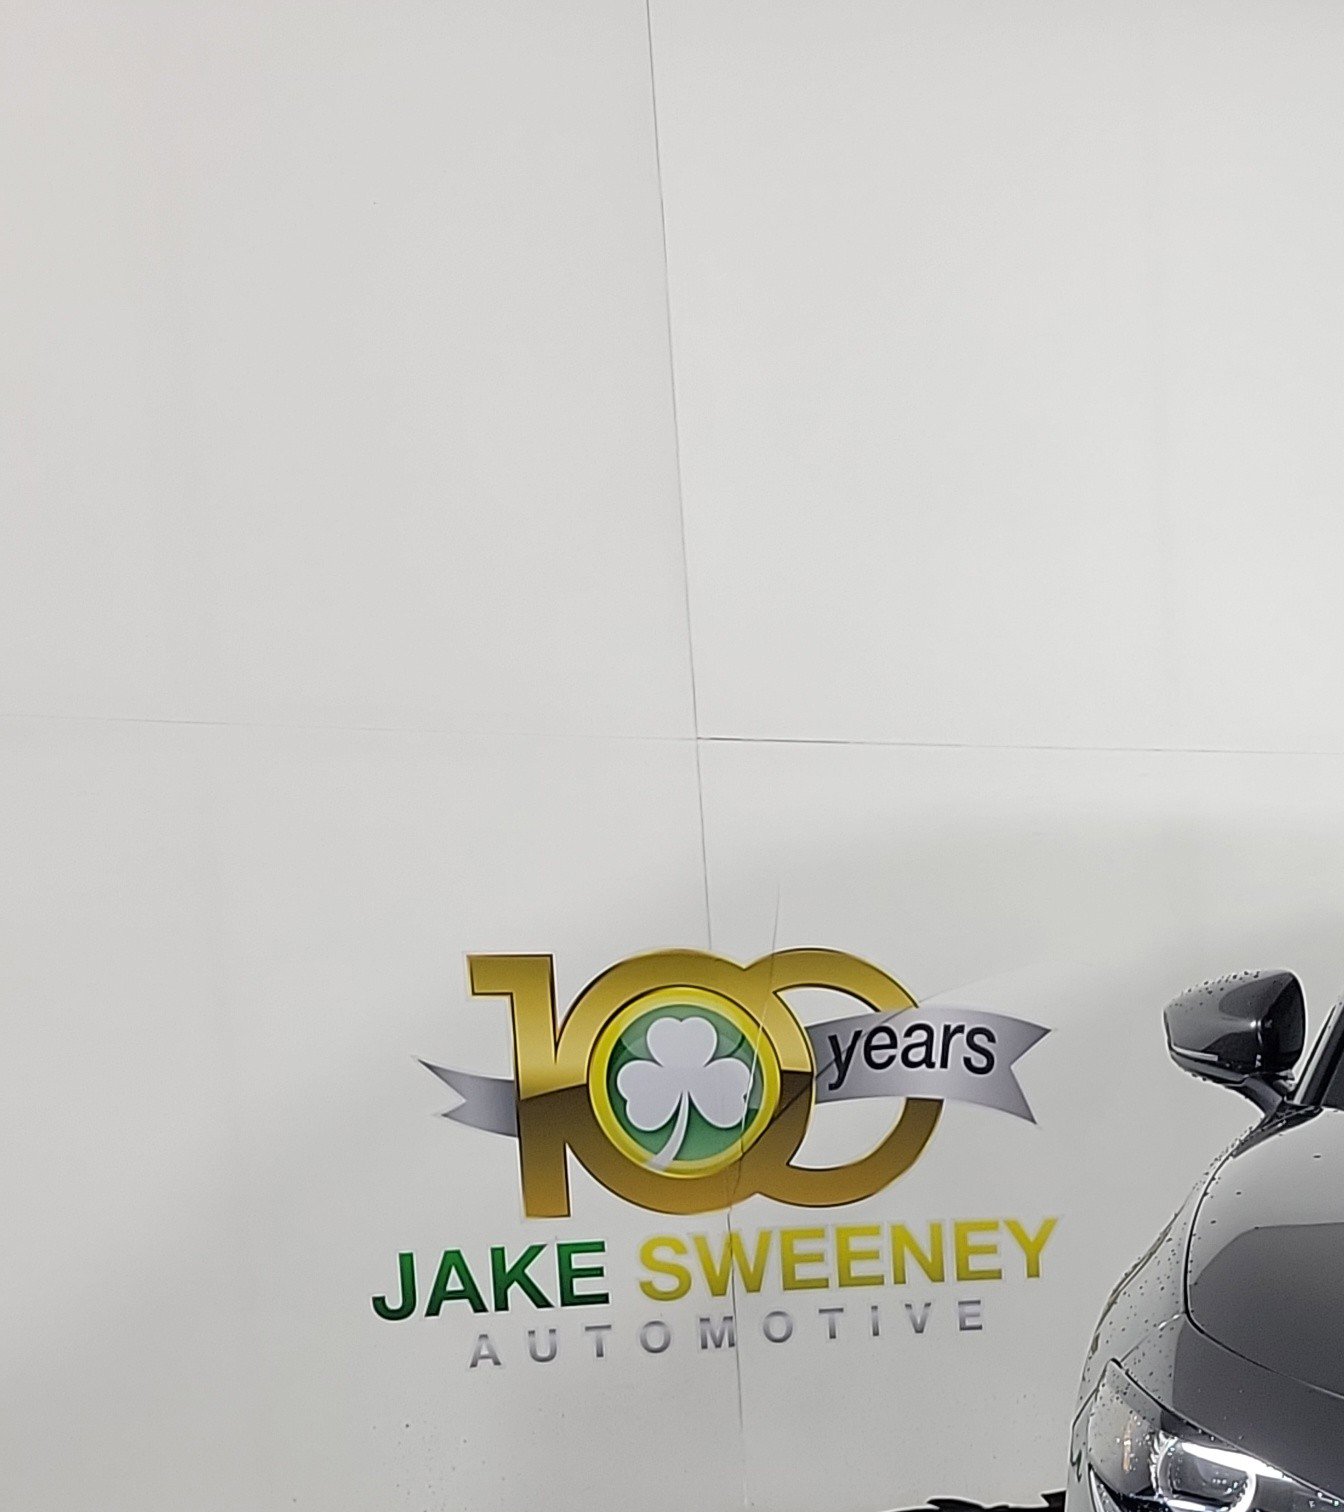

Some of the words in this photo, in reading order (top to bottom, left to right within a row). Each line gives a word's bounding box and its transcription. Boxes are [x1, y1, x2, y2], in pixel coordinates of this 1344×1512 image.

[827, 1022, 996, 1091] years
[372, 1240, 612, 1322] JAKE
[638, 1217, 1058, 1302] SWEENEY
[469, 1300, 984, 1369] AUTOMOTIVE
